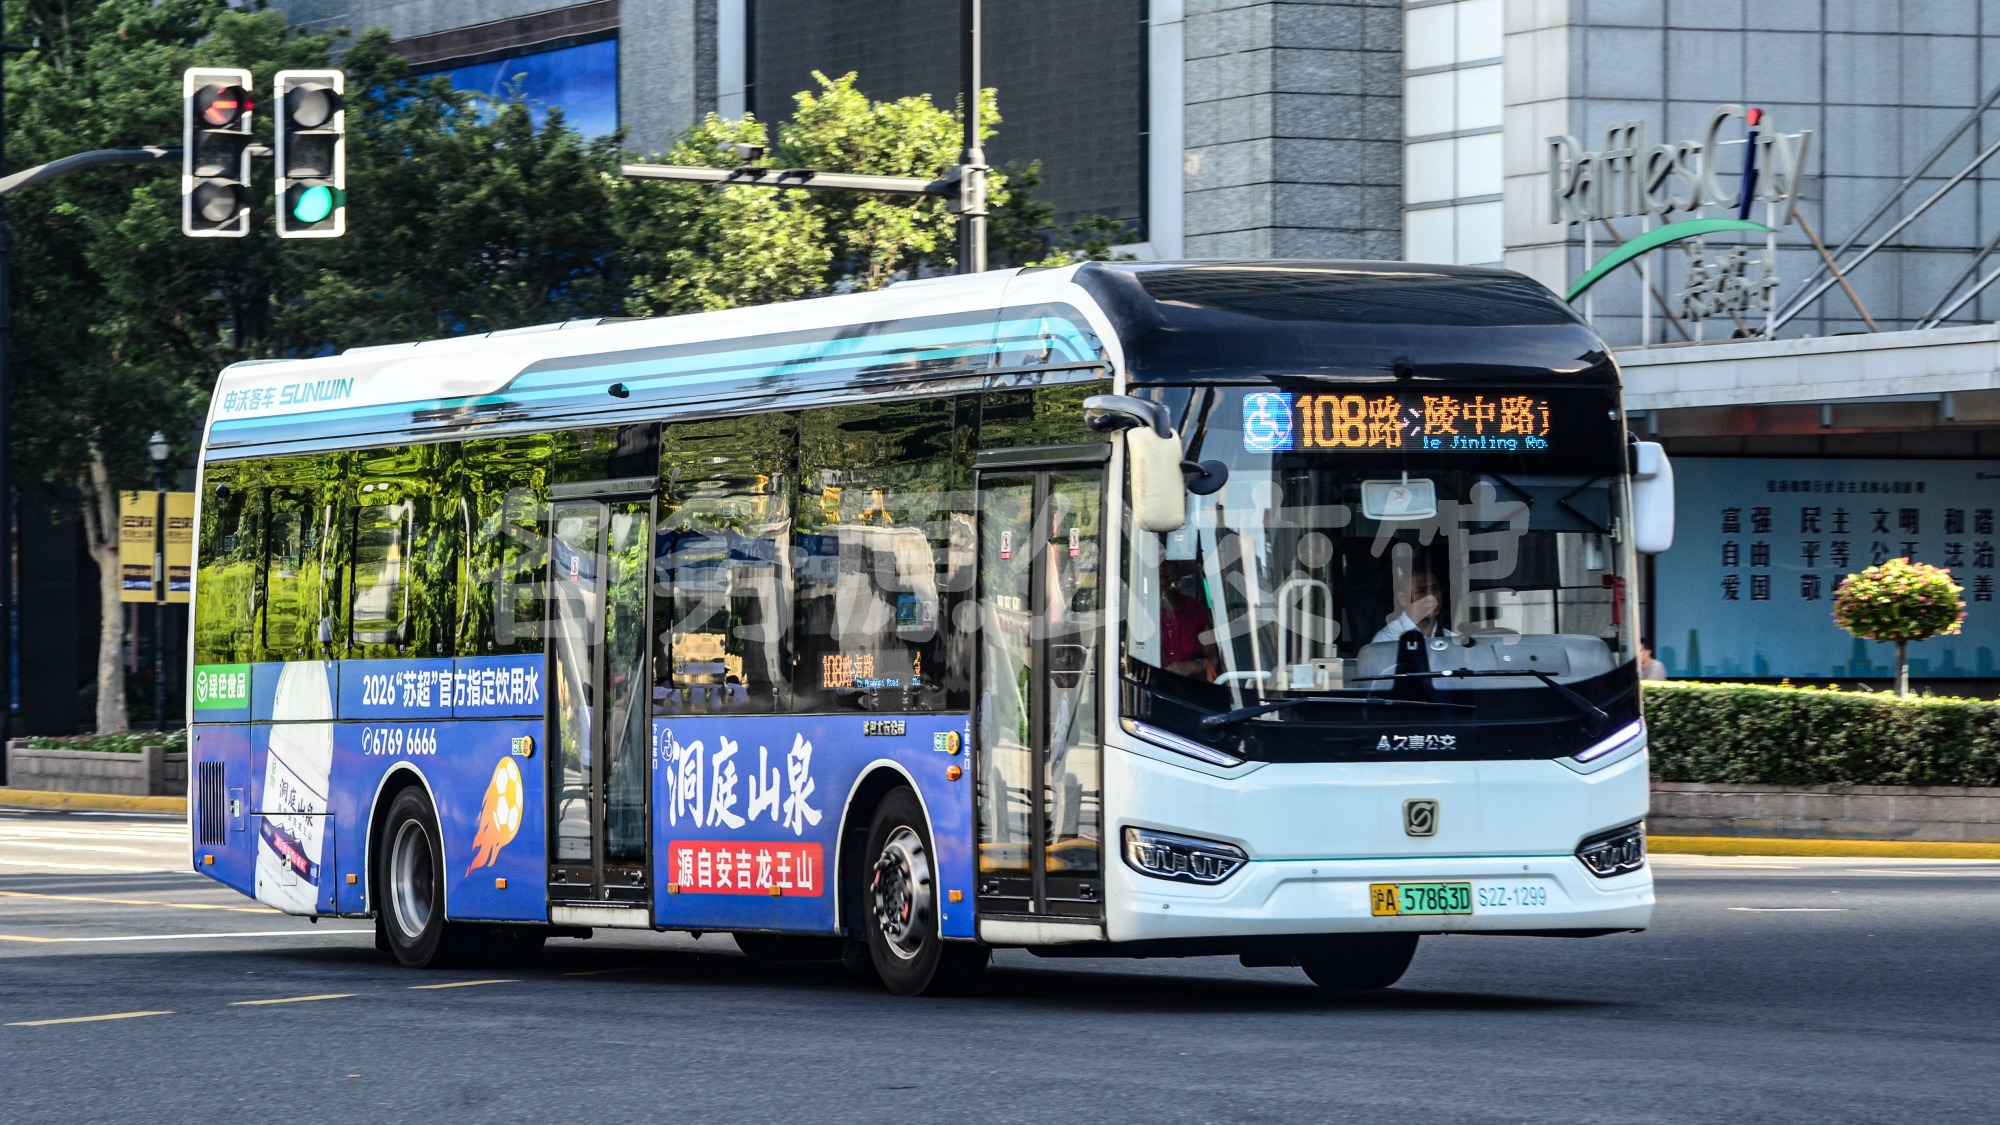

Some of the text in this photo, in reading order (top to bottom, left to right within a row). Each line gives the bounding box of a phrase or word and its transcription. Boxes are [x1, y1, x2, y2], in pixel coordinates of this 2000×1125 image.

[223, 378, 355, 412] 申沃客车 SUNWIN
[1296, 395, 1402, 449] 108路
[1450, 435, 1518, 451] Jinling
[1720, 506, 1994, 536] 富强 民主 文明 和谐
[1720, 540, 1772, 568] 自由
[1800, 540, 1851, 569] 平等
[1943, 542, 1995, 569] 法治
[1720, 574, 1772, 602] 爱国
[208, 672, 246, 698] 绿色食品
[362, 666, 540, 708] 2026“苏超”官方指定饮用水
[372, 728, 437, 756] 6769 6666
[1393, 735, 1457, 751] 久事公交
[666, 732, 823, 836] 洞庭山泉
[279, 778, 314, 827] 洞庭山泉
[677, 847, 813, 891] 源自安吉龙王山
[1405, 887, 1471, 911] 57863D
[1478, 886, 1547, 907] S2Z-1299
